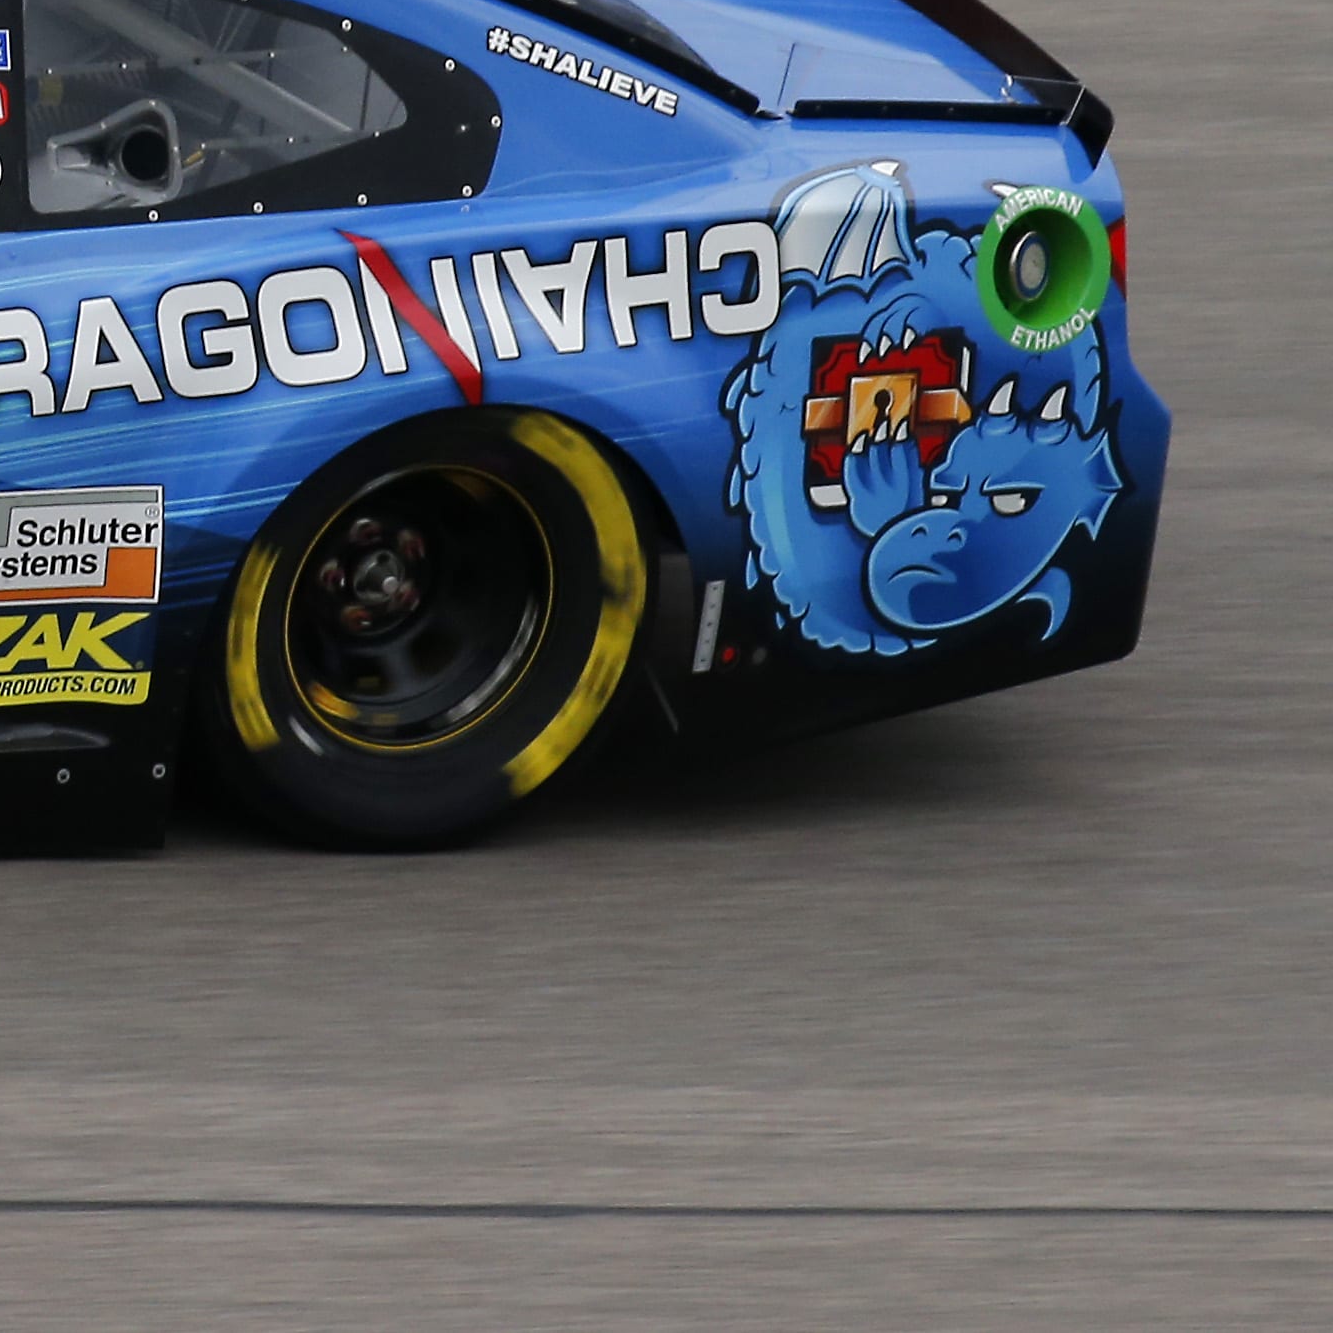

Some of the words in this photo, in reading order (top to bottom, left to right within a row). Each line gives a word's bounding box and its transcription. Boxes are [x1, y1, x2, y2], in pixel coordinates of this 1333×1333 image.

[487, 26, 679, 117] #SHALIEVE
[994, 187, 1084, 232] AMERICAN
[1010, 306, 1096, 350] ETHANOL
[16, 517, 159, 548] Schluter
